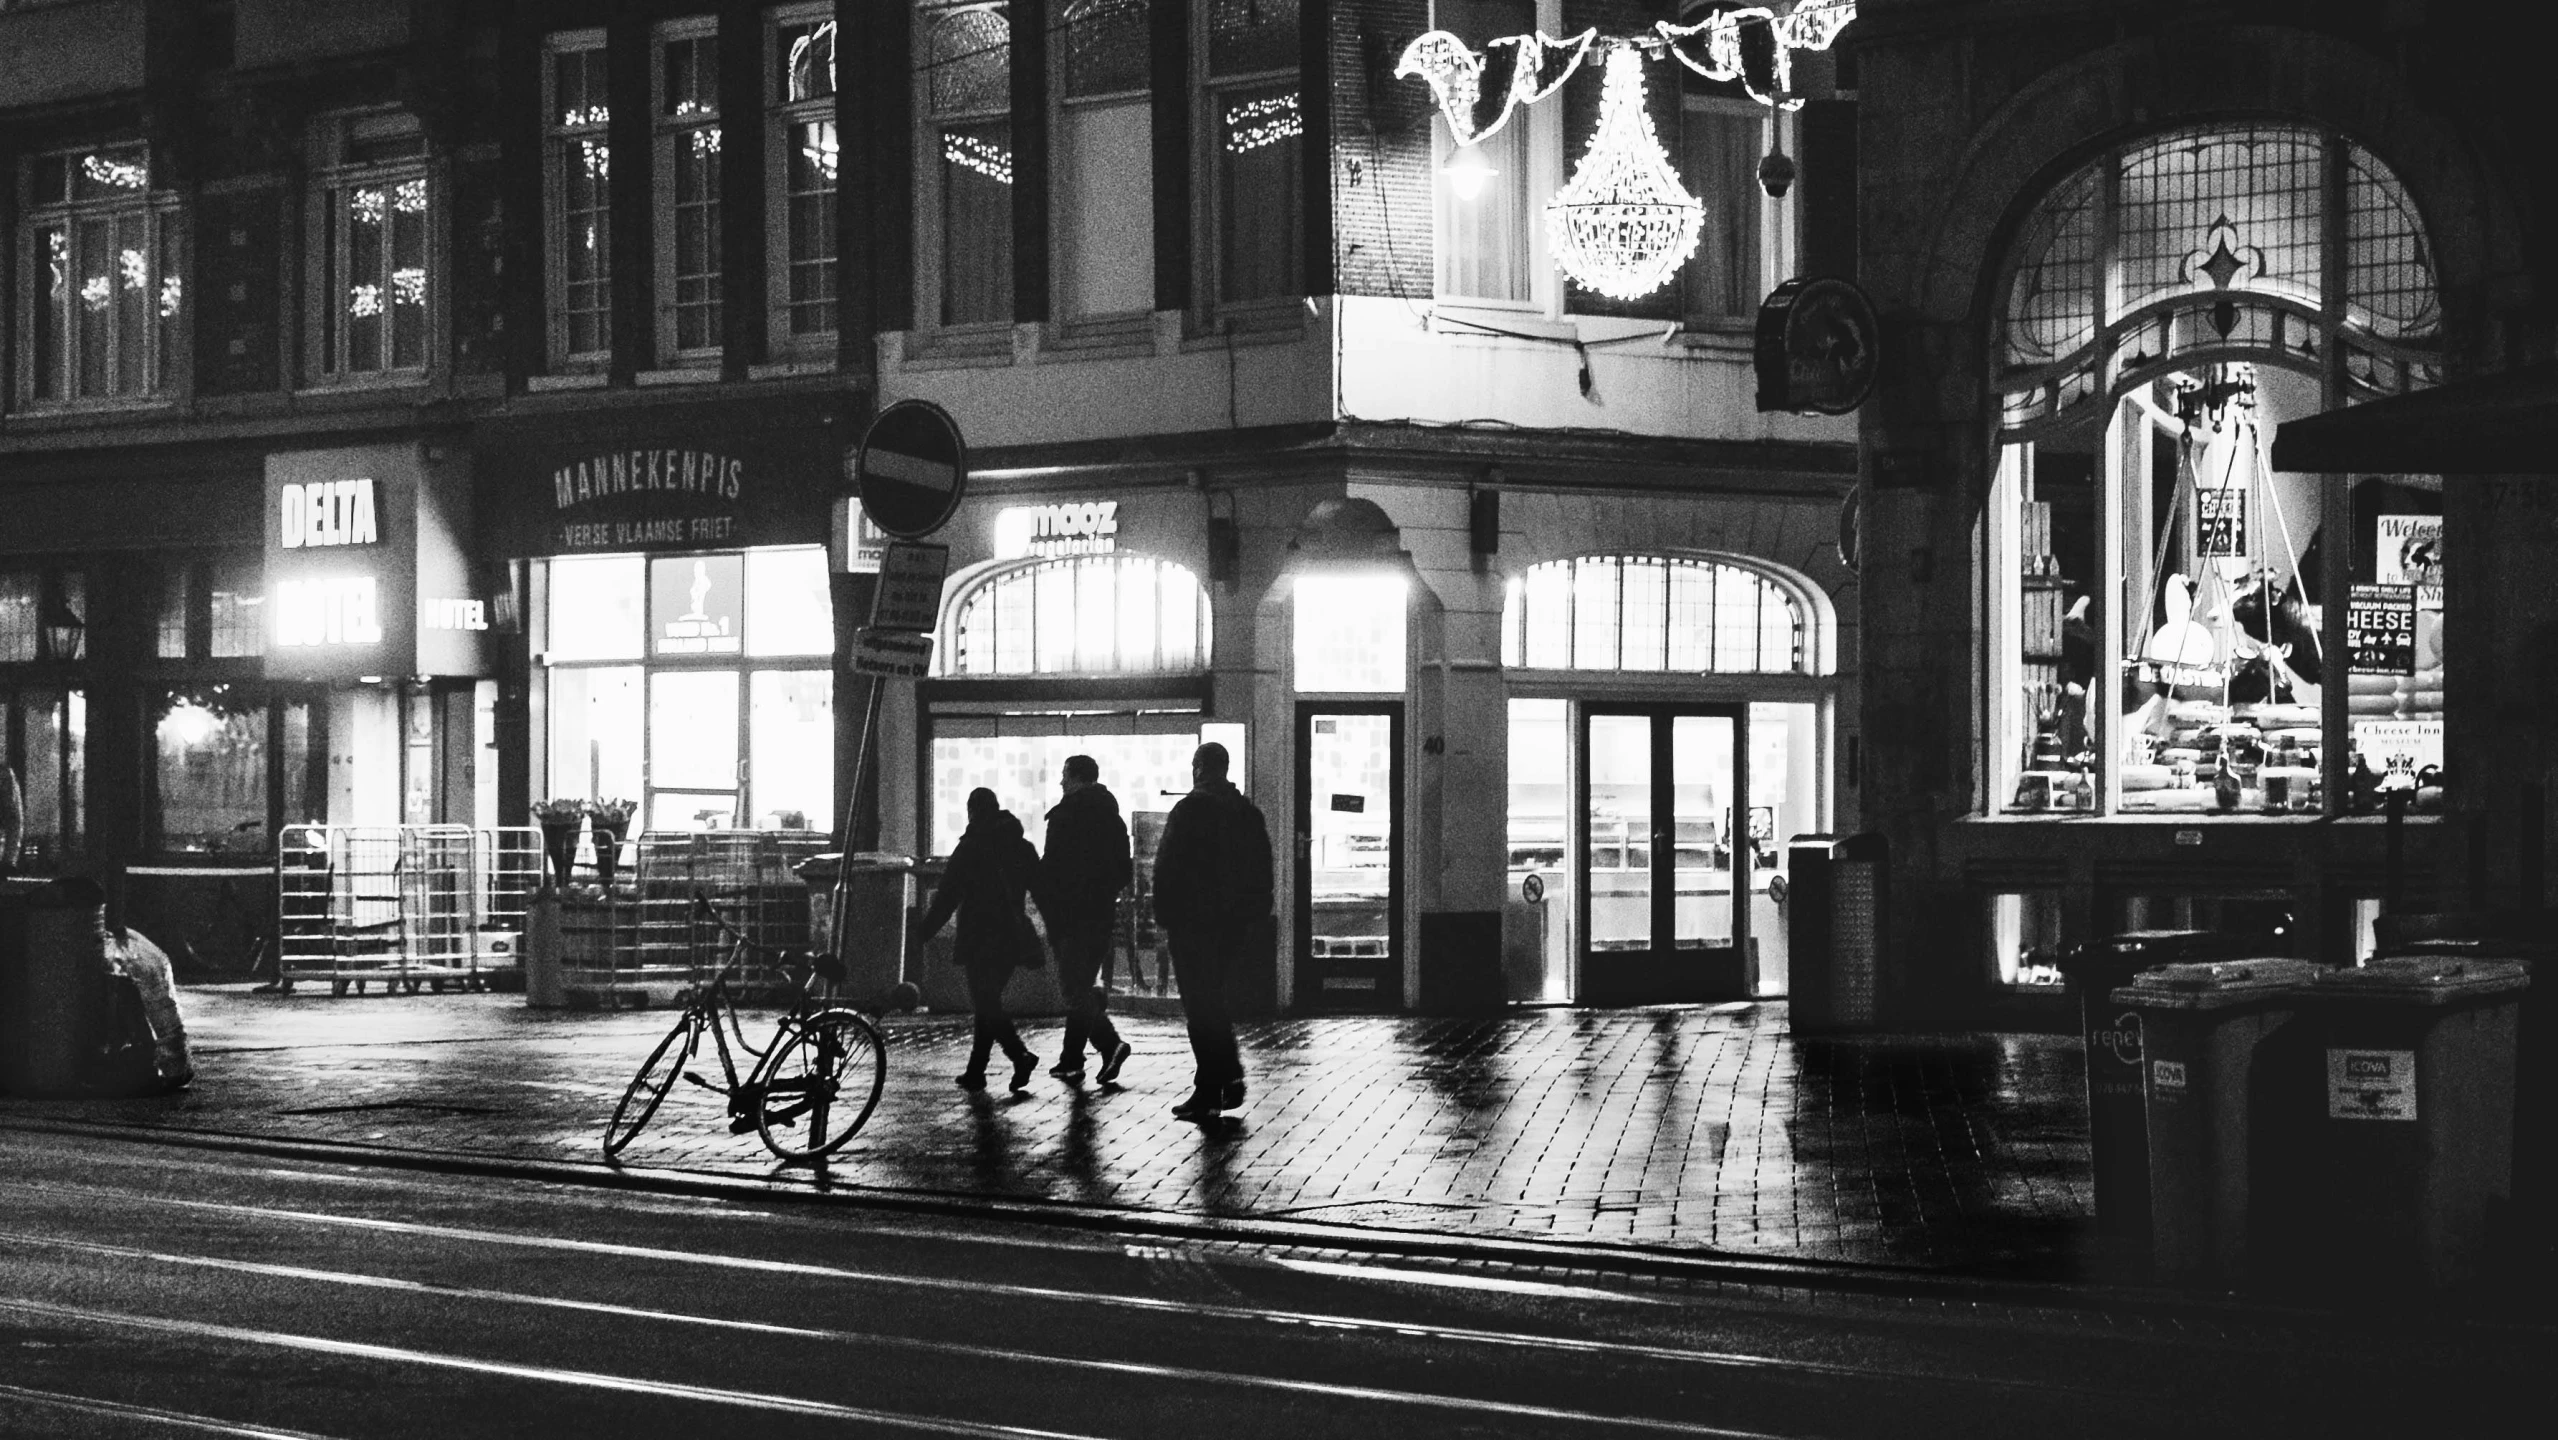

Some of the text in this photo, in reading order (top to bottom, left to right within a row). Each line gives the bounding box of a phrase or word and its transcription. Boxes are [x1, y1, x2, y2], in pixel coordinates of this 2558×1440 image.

[555, 449, 742, 509] MANNEKENPIS
[281, 478, 377, 549] DELTA
[1030, 501, 1118, 537] maoz
[616, 519, 684, 544] VLAAMSE
[277, 577, 382, 647] HOTEL
[425, 598, 488, 630] HOTEL
[2351, 602, 2412, 611] VACUUM PACKED
[2347, 611, 2412, 630] HEESE
[2363, 725, 2440, 735] Cheese Inn
[1423, 735, 1445, 756] 40
[2350, 1060, 2387, 1073] ICOVA
